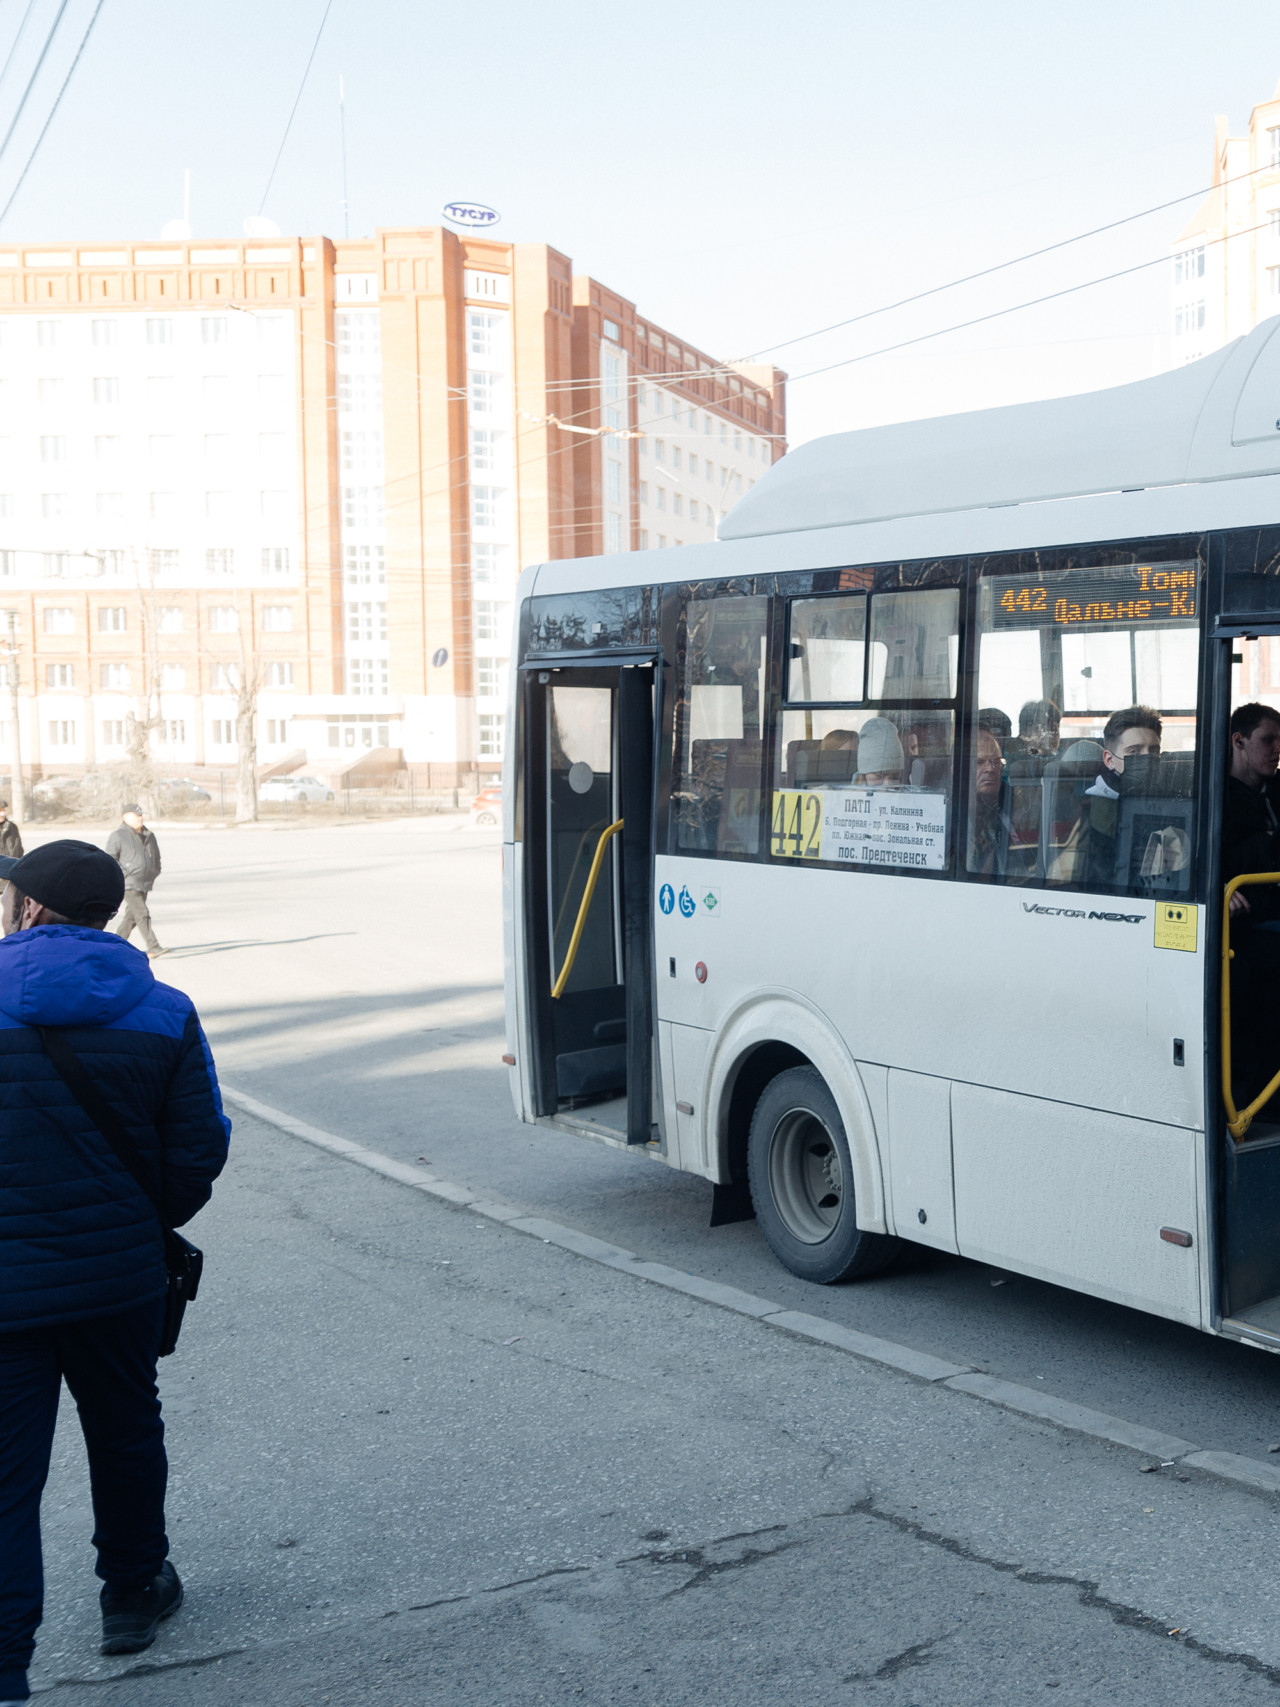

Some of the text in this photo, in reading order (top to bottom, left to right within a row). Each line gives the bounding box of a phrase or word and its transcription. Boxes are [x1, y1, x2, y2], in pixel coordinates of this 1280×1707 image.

[449, 205, 496, 221] ТУСУР
[1001, 587, 1048, 612] 442
[844, 799, 871, 814] ПАТП
[879, 806, 889, 816] ул.
[890, 805, 924, 817] Калинина
[771, 794, 821, 857] 442
[833, 817, 867, 829] Подгорная
[873, 821, 884, 831] пр.
[885, 820, 909, 831] Ленина
[915, 822, 944, 833] Учебная
[888, 833, 924, 845] Зональная
[925, 838, 936, 847] ст.
[838, 846, 927, 866] пос. Предтеченск
